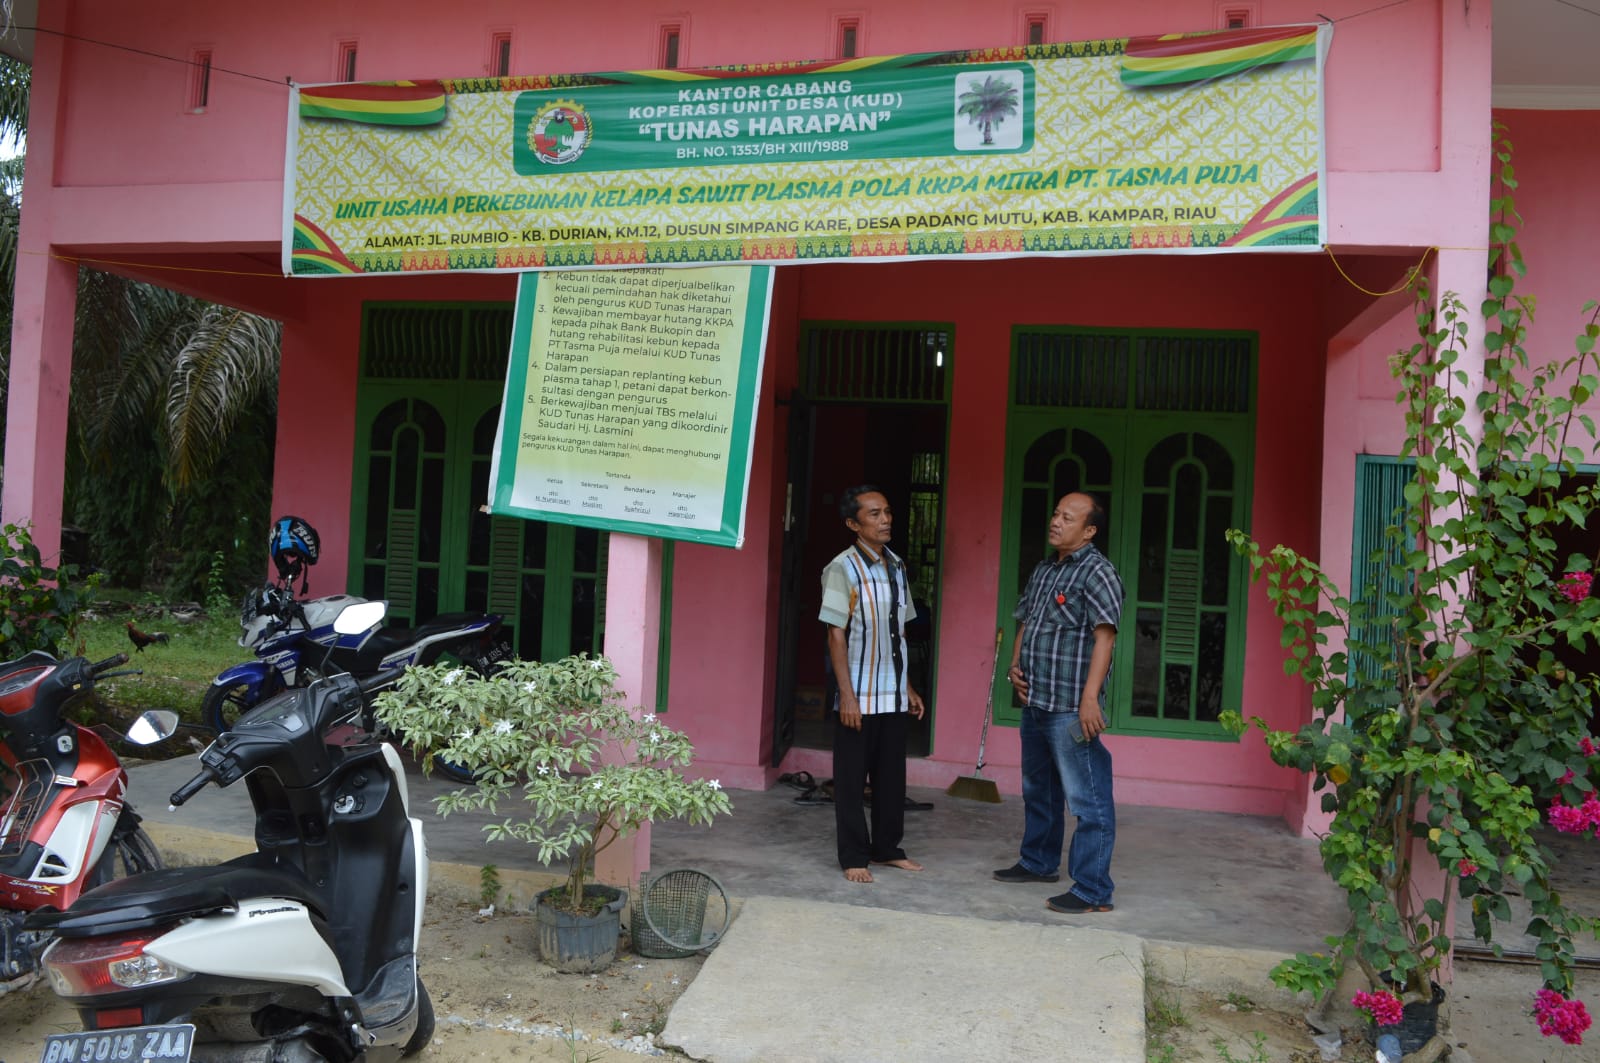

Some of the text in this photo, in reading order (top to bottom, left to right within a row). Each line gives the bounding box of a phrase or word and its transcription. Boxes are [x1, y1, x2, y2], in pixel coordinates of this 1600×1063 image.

[678, 80, 852, 102] KANTOR CABANG
[629, 92, 903, 119] KOPERASI UNIT DESA (KUD)
[639, 111, 891, 142] “TUNAS HARAPAN”
[676, 140, 849, 159] BH. NO. 1353/BH XIII/1988
[335, 164, 1259, 219] UNIT USAHA PERKEBUNAN KELAPA SAWIT PLASMA POLA KKPA MITRA PT. TASMA PUJA
[364, 235, 425, 248] ALAMAT:
[427, 234, 447, 246] JL.
[450, 231, 509, 244] RUMBIO
[522, 230, 545, 242] KB.
[549, 227, 611, 241] DURIAN,
[615, 225, 661, 239] KM.12,
[665, 223, 721, 237] DUSUN
[725, 220, 799, 234] SIMPANG
[804, 218, 851, 232] KARE,
[856, 216, 901, 230] DESA
[906, 214, 979, 228] PADANG
[984, 212, 1037, 226] MUTU,
[1042, 210, 1083, 223] KAB.
[1088, 208, 1168, 222] KAMPAR,
[1174, 206, 1217, 220] RIAU
[543, 271, 735, 292] 2. Kebun tidak dapat diperjualbelikan
[555, 283, 731, 303] kecuali pemindahan hak diketahui
[538, 304, 734, 327] 3. Kewajiban membayar hutang KKPA
[553, 295, 732, 315] oleh pengurus KUD Tunas Harapan
[549, 328, 720, 350] hutang rehabilitasi kebun kepada
[551, 317, 716, 338] kepada pihak Bank Bukopin dan
[546, 351, 589, 363] Harapan
[548, 339, 721, 362] PT Tasma Puja melalui KUD Tunas
[531, 361, 722, 386] 4. Dalam persiapan replanting kebun
[541, 385, 668, 405] sultasi dengan pengurus
[543, 374, 580, 385] plasma
[582, 378, 612, 388] tahap
[622, 382, 656, 391] petani
[657, 383, 688, 395] dapat
[690, 386, 732, 398] berkon-
[527, 394, 718, 421] 5. Berkewajiban menjual TBS melalui
[538, 418, 633, 437] Saudari Hj. Lasmini
[539, 407, 729, 434] KUD Tunas Harapan yang dikoordinir
[521, 441, 556, 451] pengurus
[557, 444, 574, 453] KUD
[575, 446, 598, 455] Tunas
[522, 432, 546, 442] Segala
[547, 434, 591, 446] kekurangan
[592, 438, 616, 449] dalam
[617, 440, 628, 450] hal
[642, 445, 665, 454] dapat
[666, 447, 721, 460] menghubungi
[43, 1031, 186, 1063] BM 5015 ZAA
